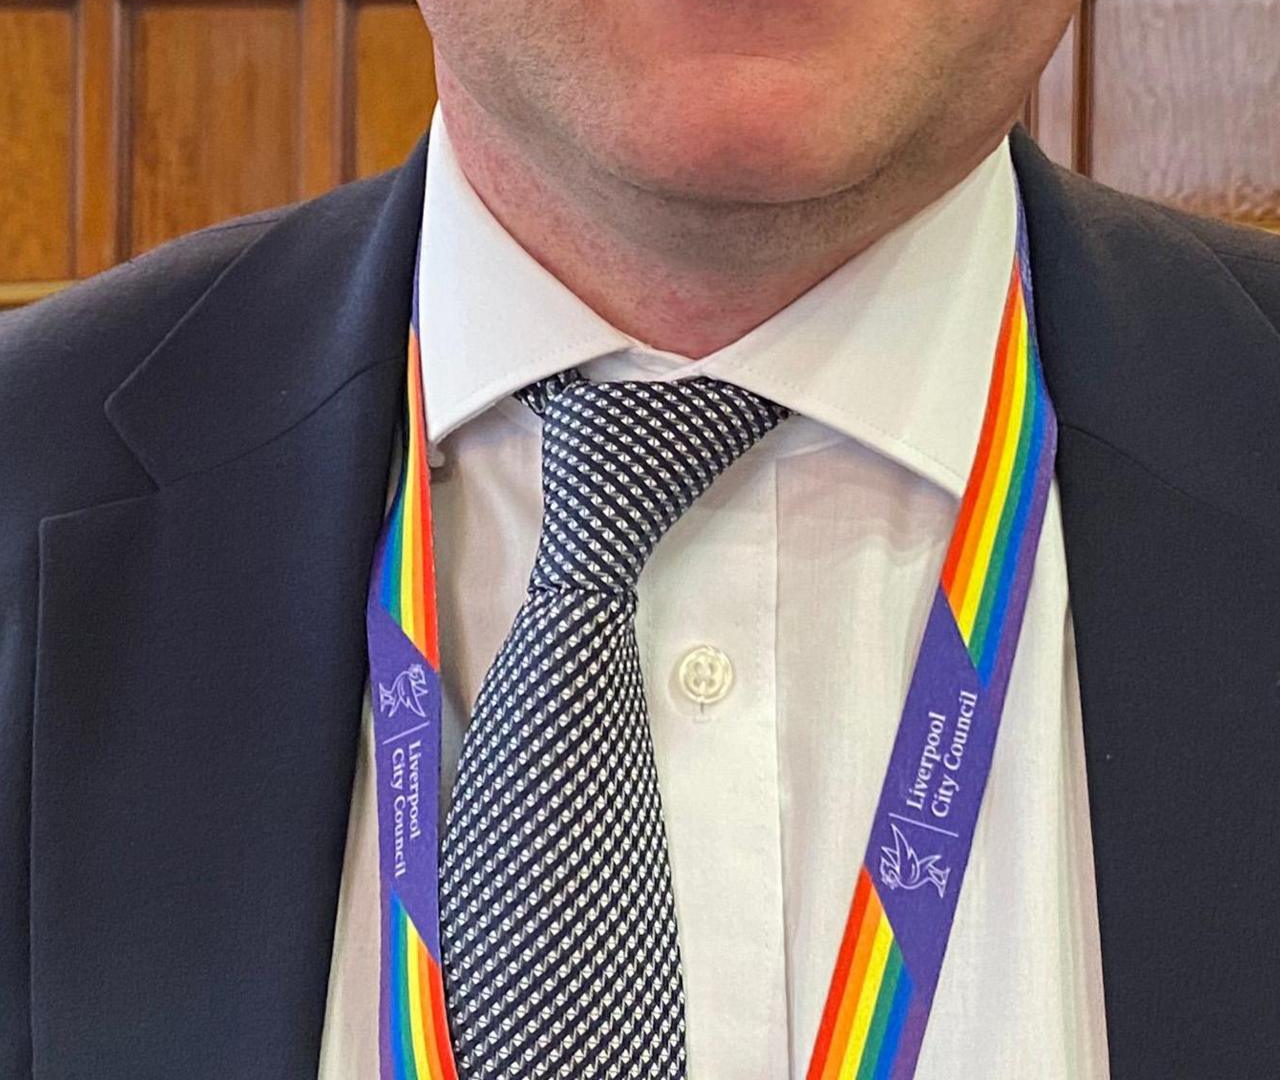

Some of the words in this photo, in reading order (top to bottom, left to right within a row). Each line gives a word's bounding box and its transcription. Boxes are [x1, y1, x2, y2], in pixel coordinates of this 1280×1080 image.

[392, 747, 407, 791] City
[906, 711, 946, 810] Liverpool
[943, 689, 978, 770] Council
[409, 739, 421, 839] Liverpool
[931, 775, 960, 818] City
[394, 795, 408, 878] Council
